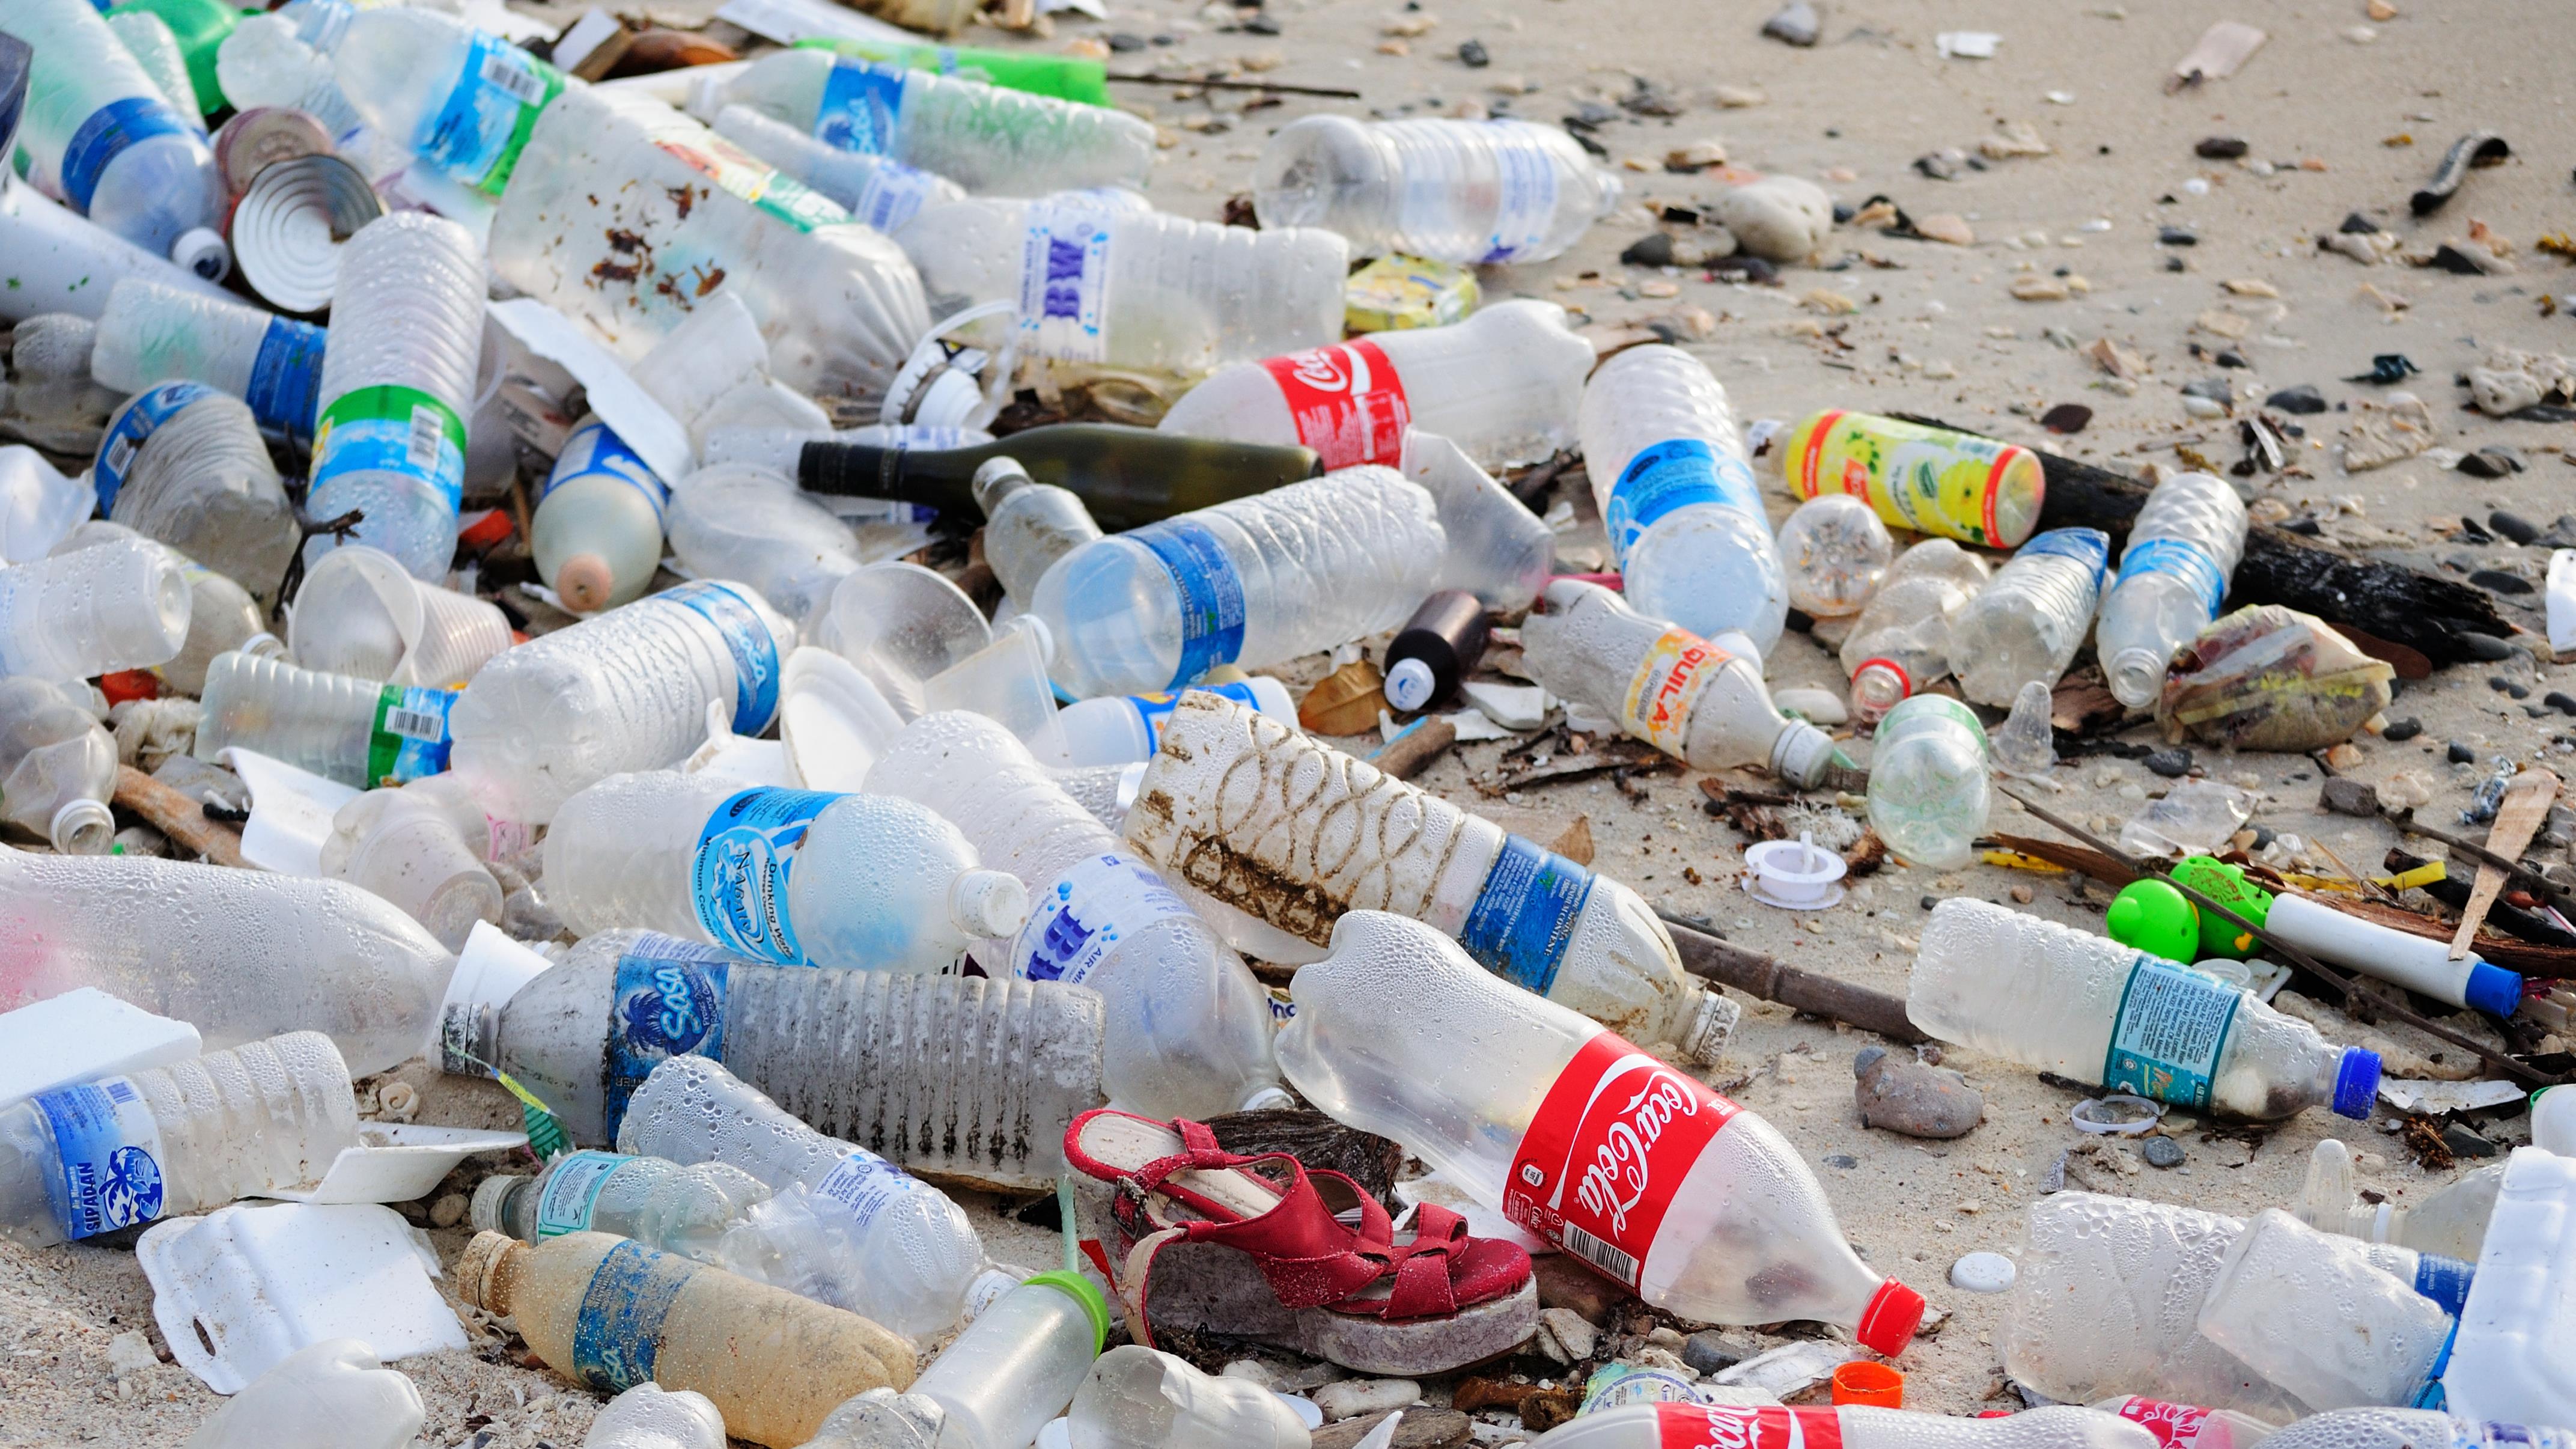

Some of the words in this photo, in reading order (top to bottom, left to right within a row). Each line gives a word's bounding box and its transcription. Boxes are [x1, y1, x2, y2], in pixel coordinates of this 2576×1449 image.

[696, 836, 713, 891] Minimum
[1557, 877, 1571, 898] 1500ml
[1561, 882, 1578, 913] MINIMUM
[761, 895, 773, 932] Osmosis
[767, 862, 777, 924] Drinking
[774, 927, 797, 960] Water
[1508, 890, 1527, 926] INDUSTRIES
[1543, 911, 1566, 957] CONTENT:
[1084, 947, 1103, 968] AIR
[654, 968, 702, 1038] Sosa
[2184, 995, 2194, 1010] Punca
[2200, 998, 2211, 1013] Punca
[2175, 1019, 2186, 1038] Source
[2179, 1017, 2196, 1050] Underground
[2190, 1027, 2201, 1045] Bawah
[2149, 1038, 2164, 1059] Malaysia
[2162, 1039, 2172, 1052] Jalan
[2176, 1050, 2186, 1064] Water
[2185, 1045, 2195, 1060] Tanah
[1574, 1070, 1697, 1242] Coca-Cola
[68, 1165, 79, 1197] Minuman
[76, 1161, 100, 1230] SIPADAN
[1530, 1206, 1542, 1228] Coke
